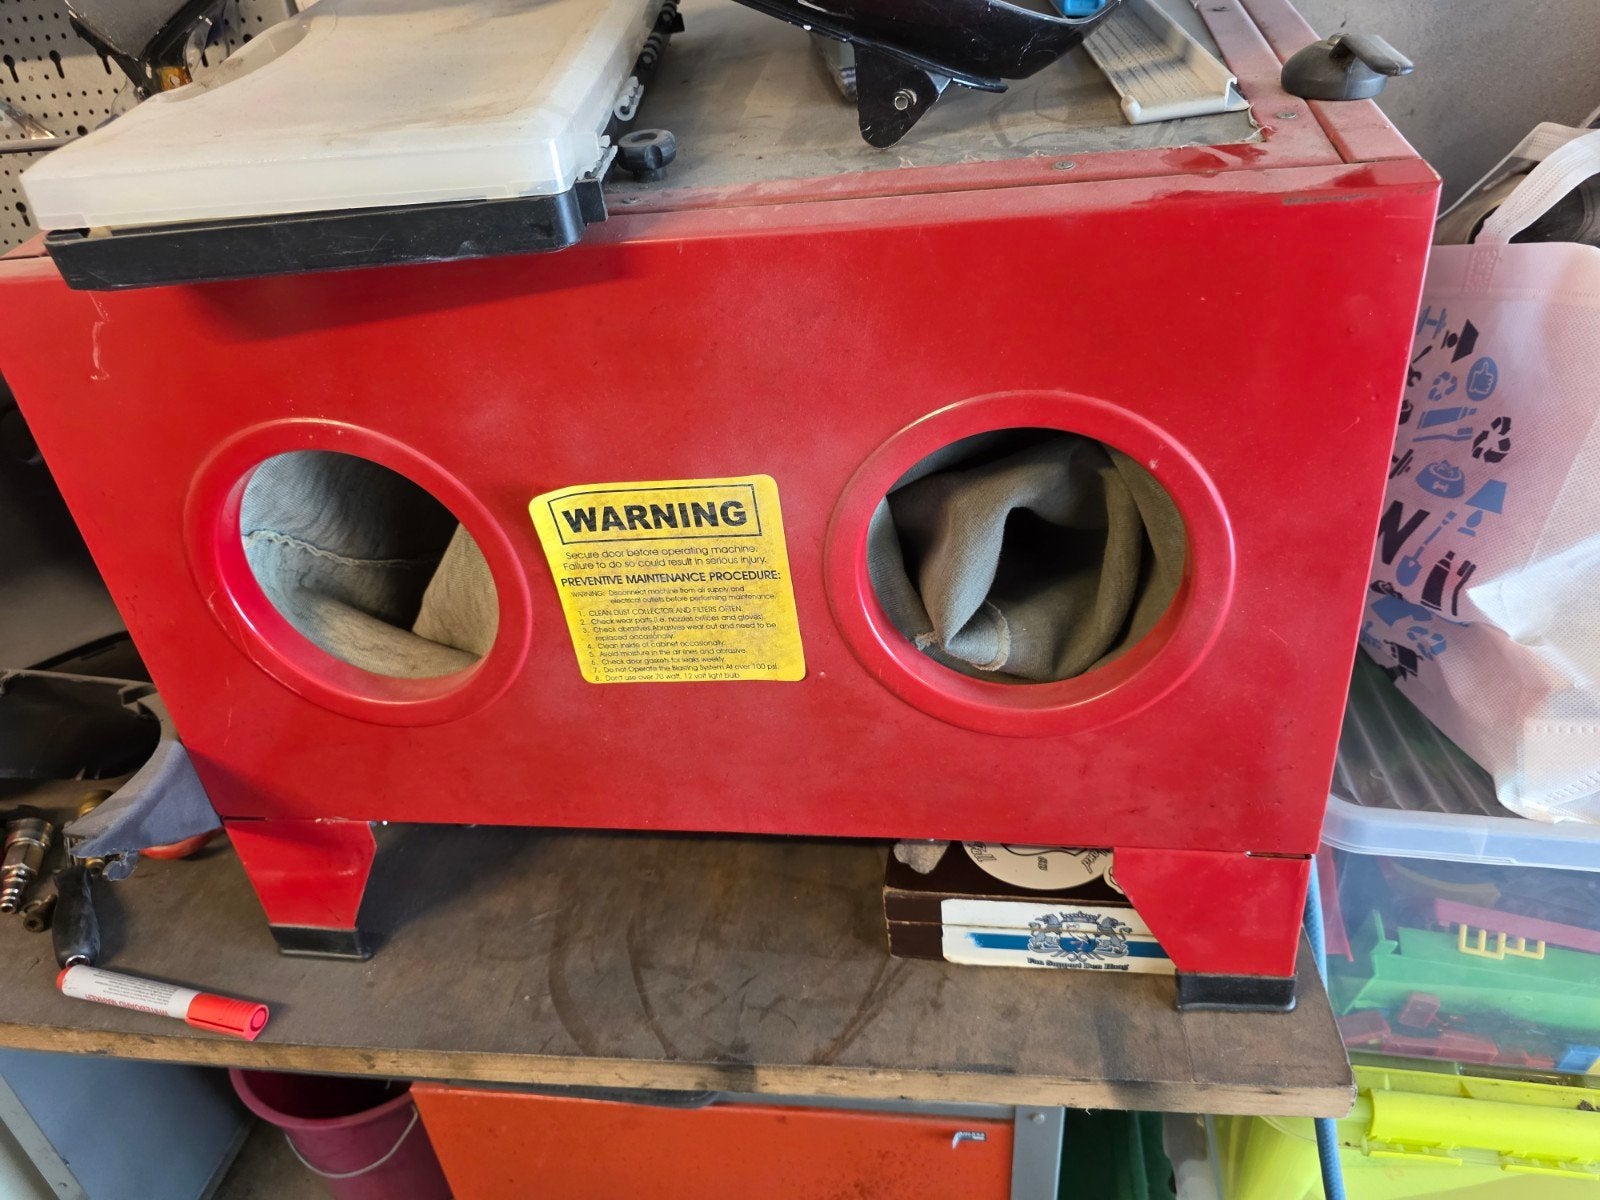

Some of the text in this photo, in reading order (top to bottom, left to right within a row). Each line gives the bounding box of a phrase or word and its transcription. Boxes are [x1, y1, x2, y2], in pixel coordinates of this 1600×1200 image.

[562, 500, 748, 533] WARNING
[565, 551, 600, 560] Secure
[626, 548, 659, 557] before
[661, 546, 709, 557] operating
[711, 545, 758, 554] machine.
[563, 562, 594, 571] Failure
[596, 561, 606, 569] to
[609, 560, 622, 568] do
[637, 558, 666, 567] could
[668, 558, 692, 566] result
[695, 557, 704, 565] in
[706, 556, 739, 565] serious
[740, 555, 767, 565] injury.
[561, 570, 781, 587] PREVENTIVE MAINTENANCE PROCEDURE:
[632, 607, 674, 615] COLLECTOR
[676, 606, 691, 614] AND
[693, 605, 717, 613] FILTERS
